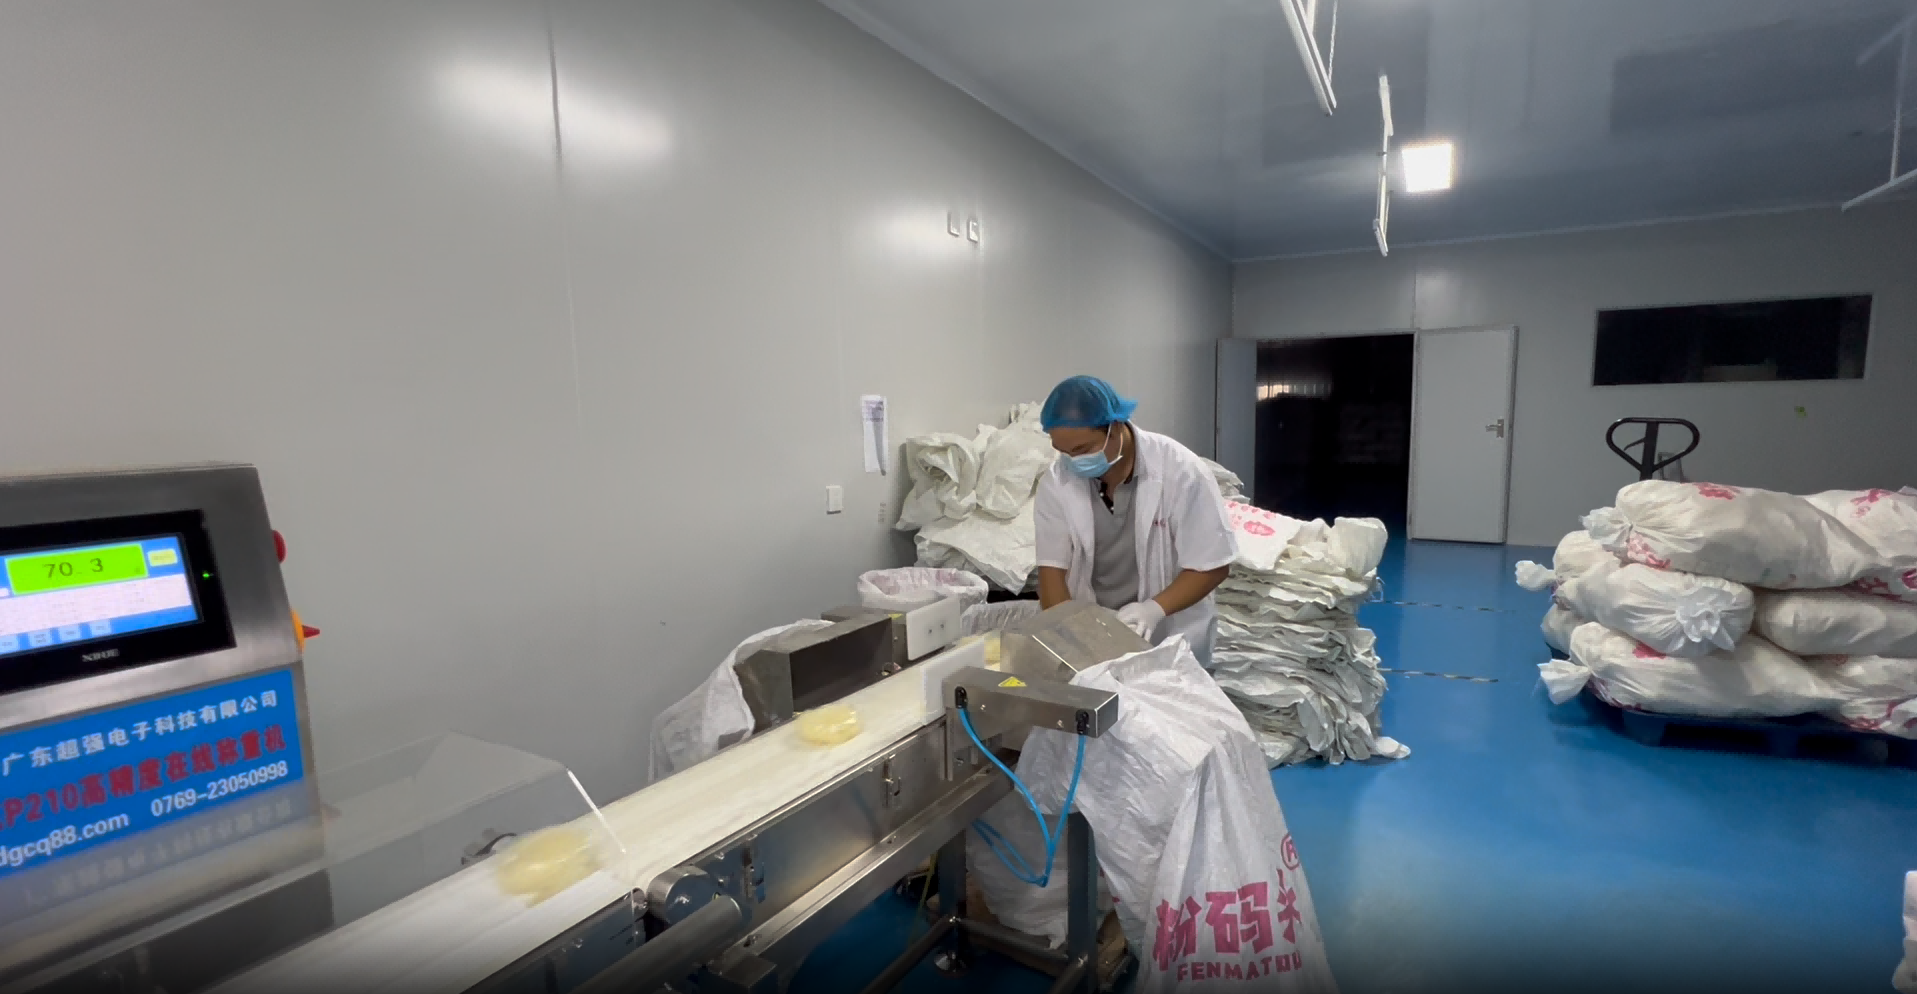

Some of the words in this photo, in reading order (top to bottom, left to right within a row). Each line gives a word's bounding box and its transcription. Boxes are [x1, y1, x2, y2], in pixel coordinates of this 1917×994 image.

[43, 557, 104, 579] 70.3
[2, 689, 278, 777] 广东超强电子科技有限公司
[0, 723, 287, 831] P210高精度在线称重机
[151, 760, 289, 817] 0769-23050998
[1177, 951, 1303, 983] FENMATOU
